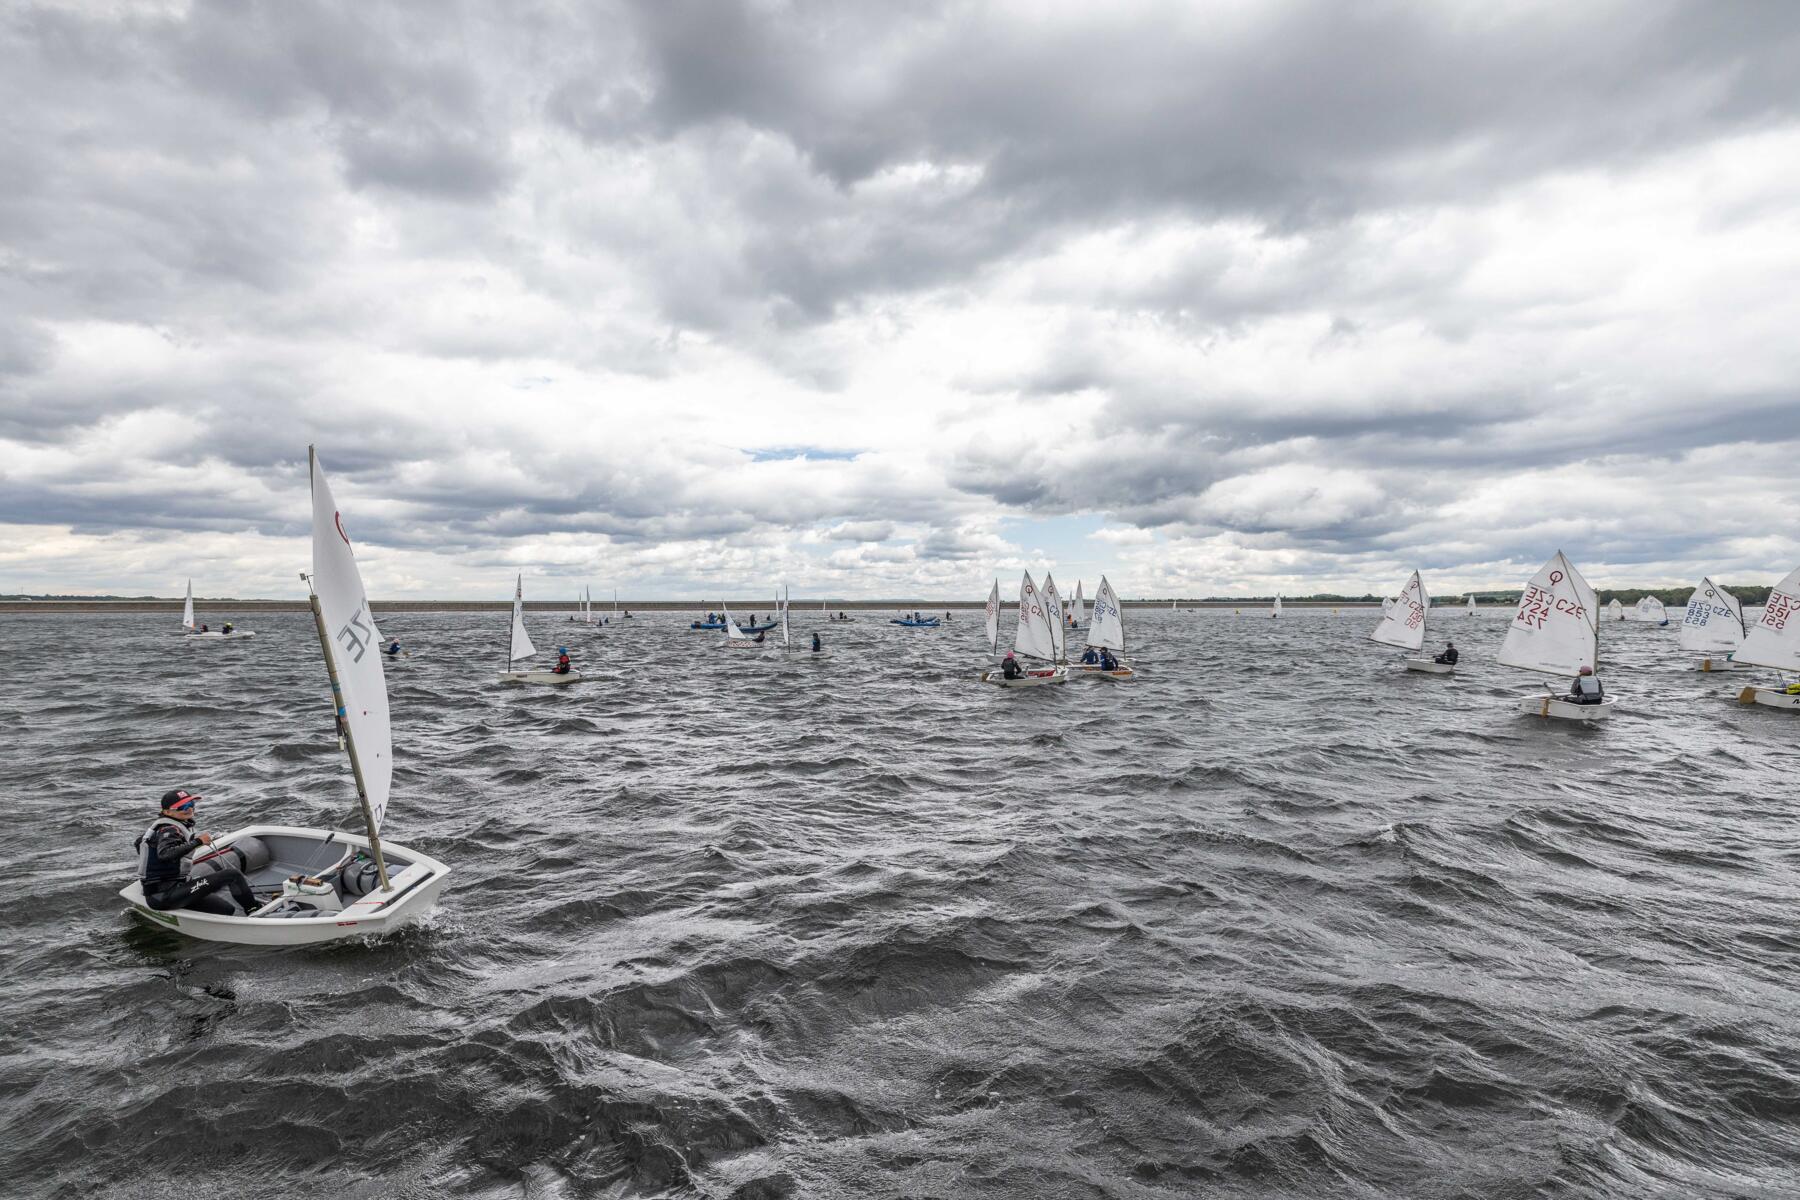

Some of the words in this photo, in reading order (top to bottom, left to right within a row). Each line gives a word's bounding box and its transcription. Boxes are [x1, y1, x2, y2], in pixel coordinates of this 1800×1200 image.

[1521, 598, 1549, 617] 724
[1556, 599, 1586, 620] CZE
[1687, 608, 1710, 620] 853
[1712, 606, 1731, 618] CZE
[1766, 603, 1790, 620] 551
